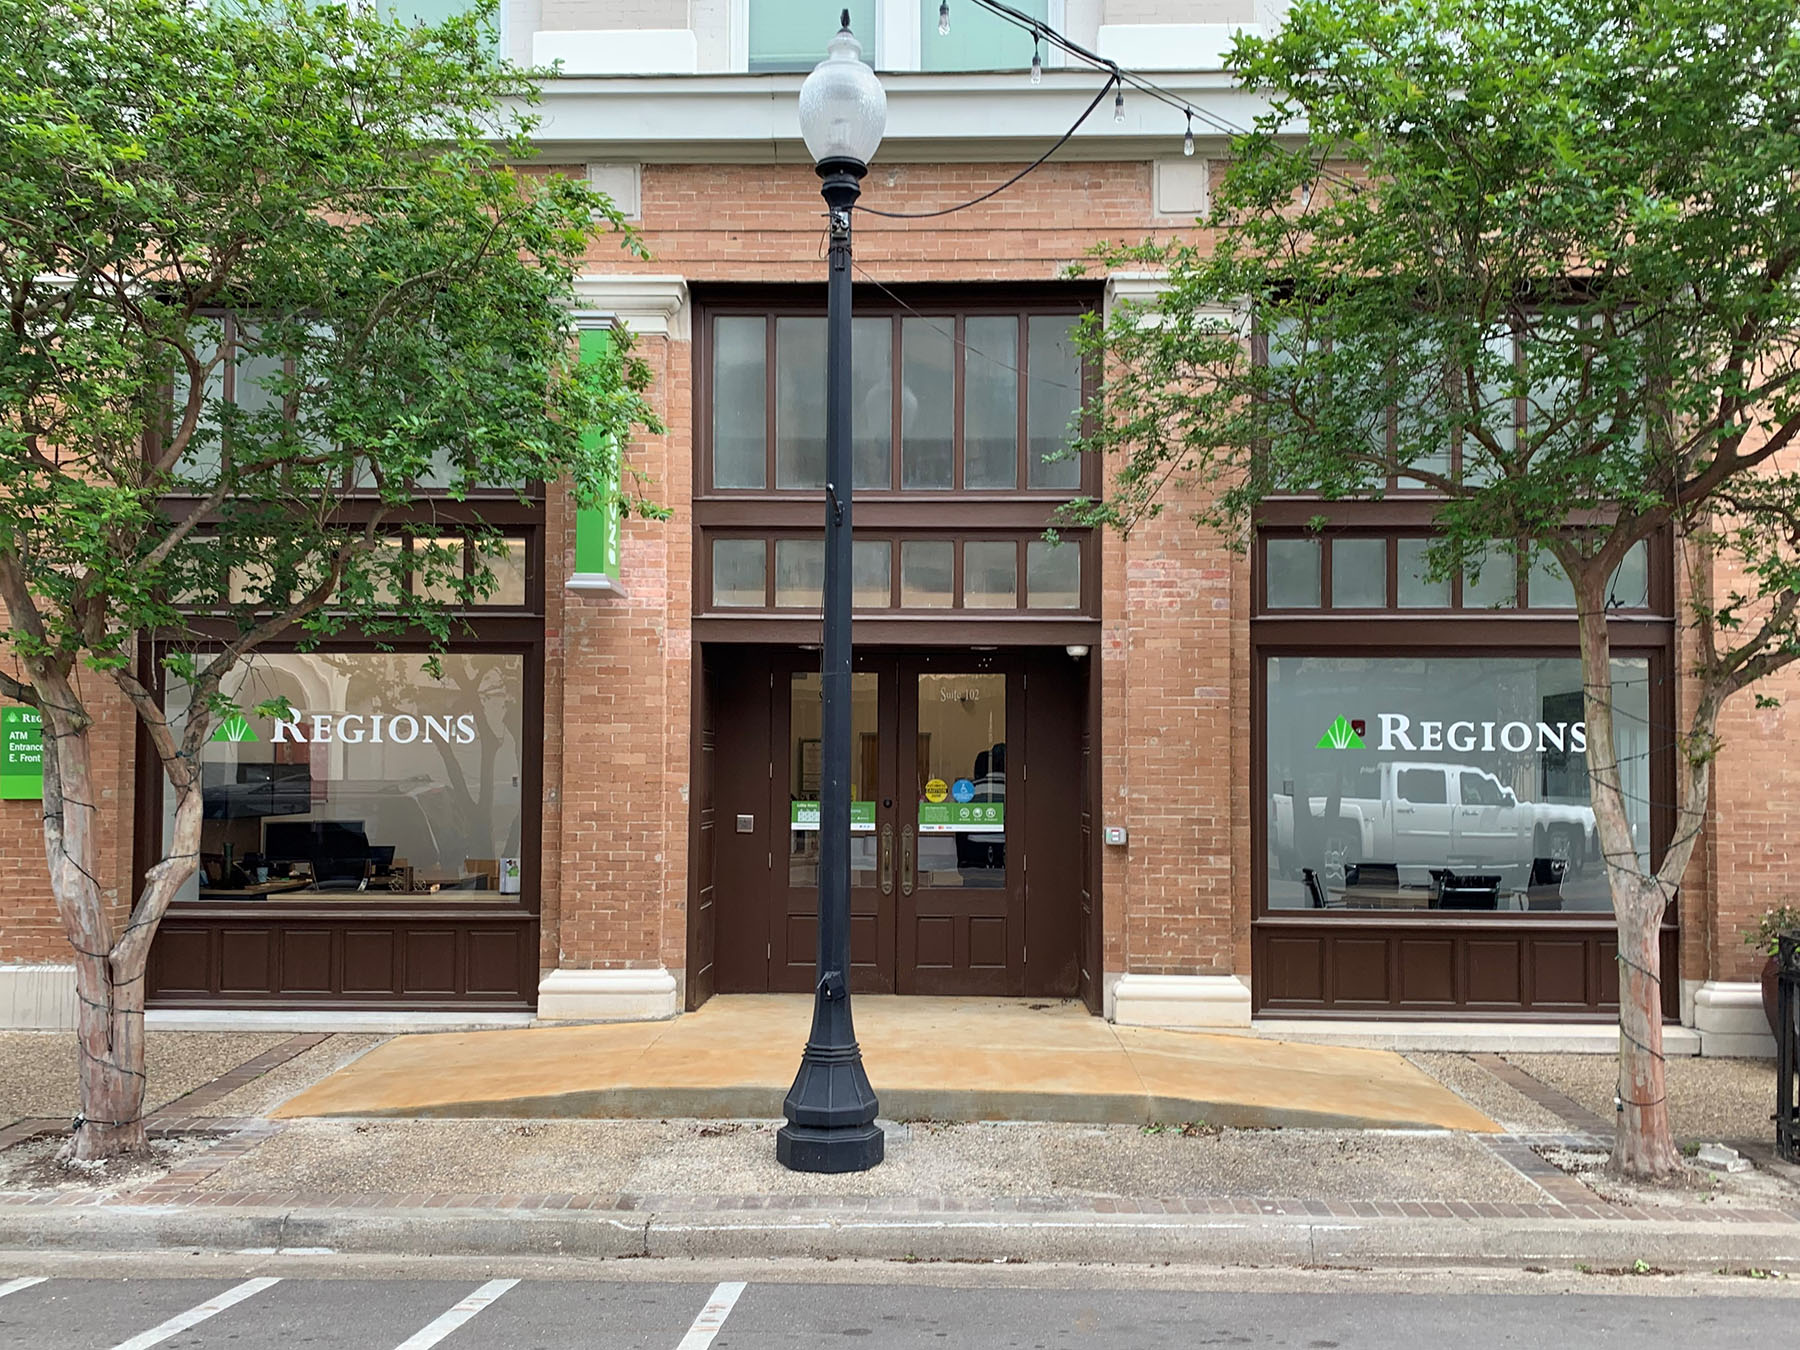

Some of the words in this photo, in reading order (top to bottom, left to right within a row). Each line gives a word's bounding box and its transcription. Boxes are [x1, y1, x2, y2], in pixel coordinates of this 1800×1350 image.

[940, 687, 962, 702] Suite
[965, 688, 980, 701] 102
[269, 707, 476, 744] REGIONS
[1377, 713, 1587, 753] REGIONS
[9, 731, 28, 740] ATM
[9, 753, 18, 763] E.
[20, 753, 41, 763] Front
